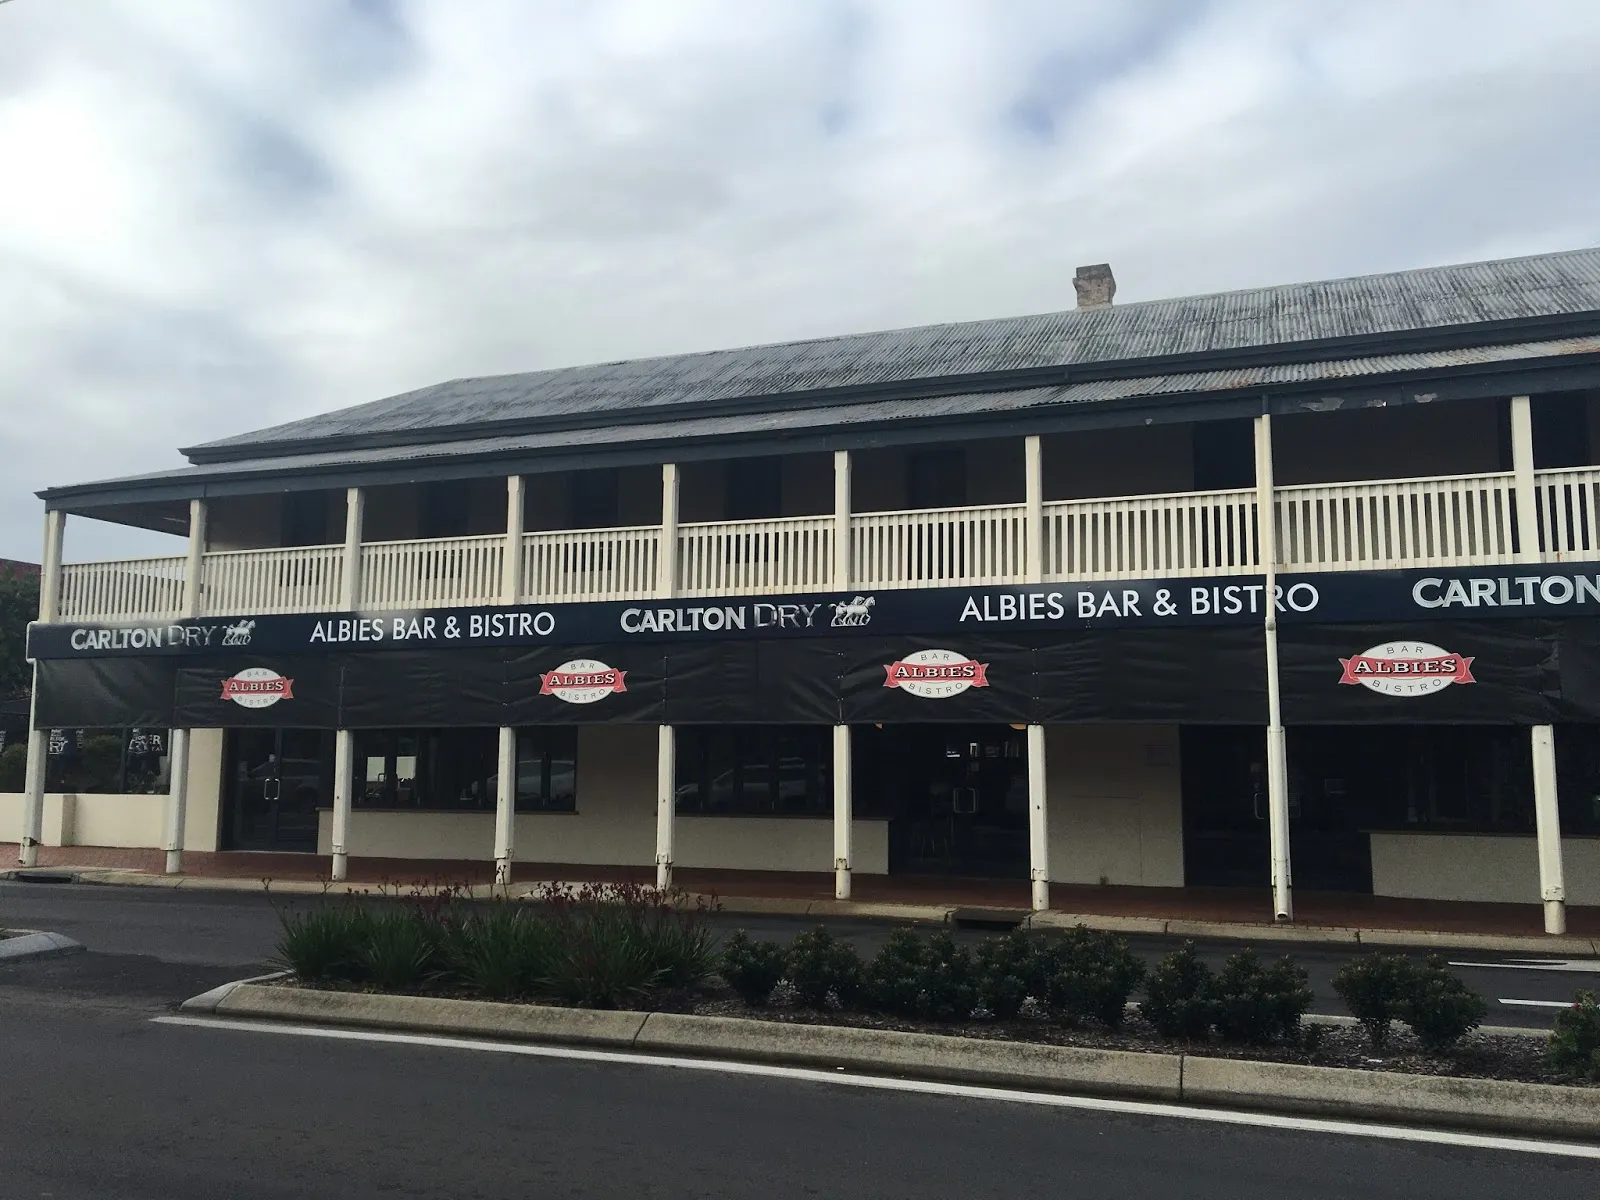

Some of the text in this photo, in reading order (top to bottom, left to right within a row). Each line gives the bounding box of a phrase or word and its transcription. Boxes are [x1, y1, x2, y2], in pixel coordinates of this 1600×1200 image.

[1412, 575, 1600, 609] CARLTON
[959, 592, 1065, 622] ALBIES
[1077, 590, 1143, 618] BAR
[1152, 588, 1178, 616] &
[619, 603, 822, 633] CARLTON DRY
[309, 611, 556, 643] ALBIES BAR & BISTRO
[70, 625, 217, 650] CARLTON DRY
[920, 653, 951, 661] BAR
[1386, 645, 1424, 655] BAR
[570, 662, 596, 670] BAR
[895, 665, 976, 680] ALBIES
[1353, 658, 1457, 675] ALBIES
[228, 680, 284, 692] ALBIES
[548, 673, 616, 687] ALBIES
[1372, 678, 1442, 693] BISTRO
[560, 688, 606, 701] BISTRO
[908, 682, 963, 695] BISTRO
[237, 695, 276, 706] BISTRO
